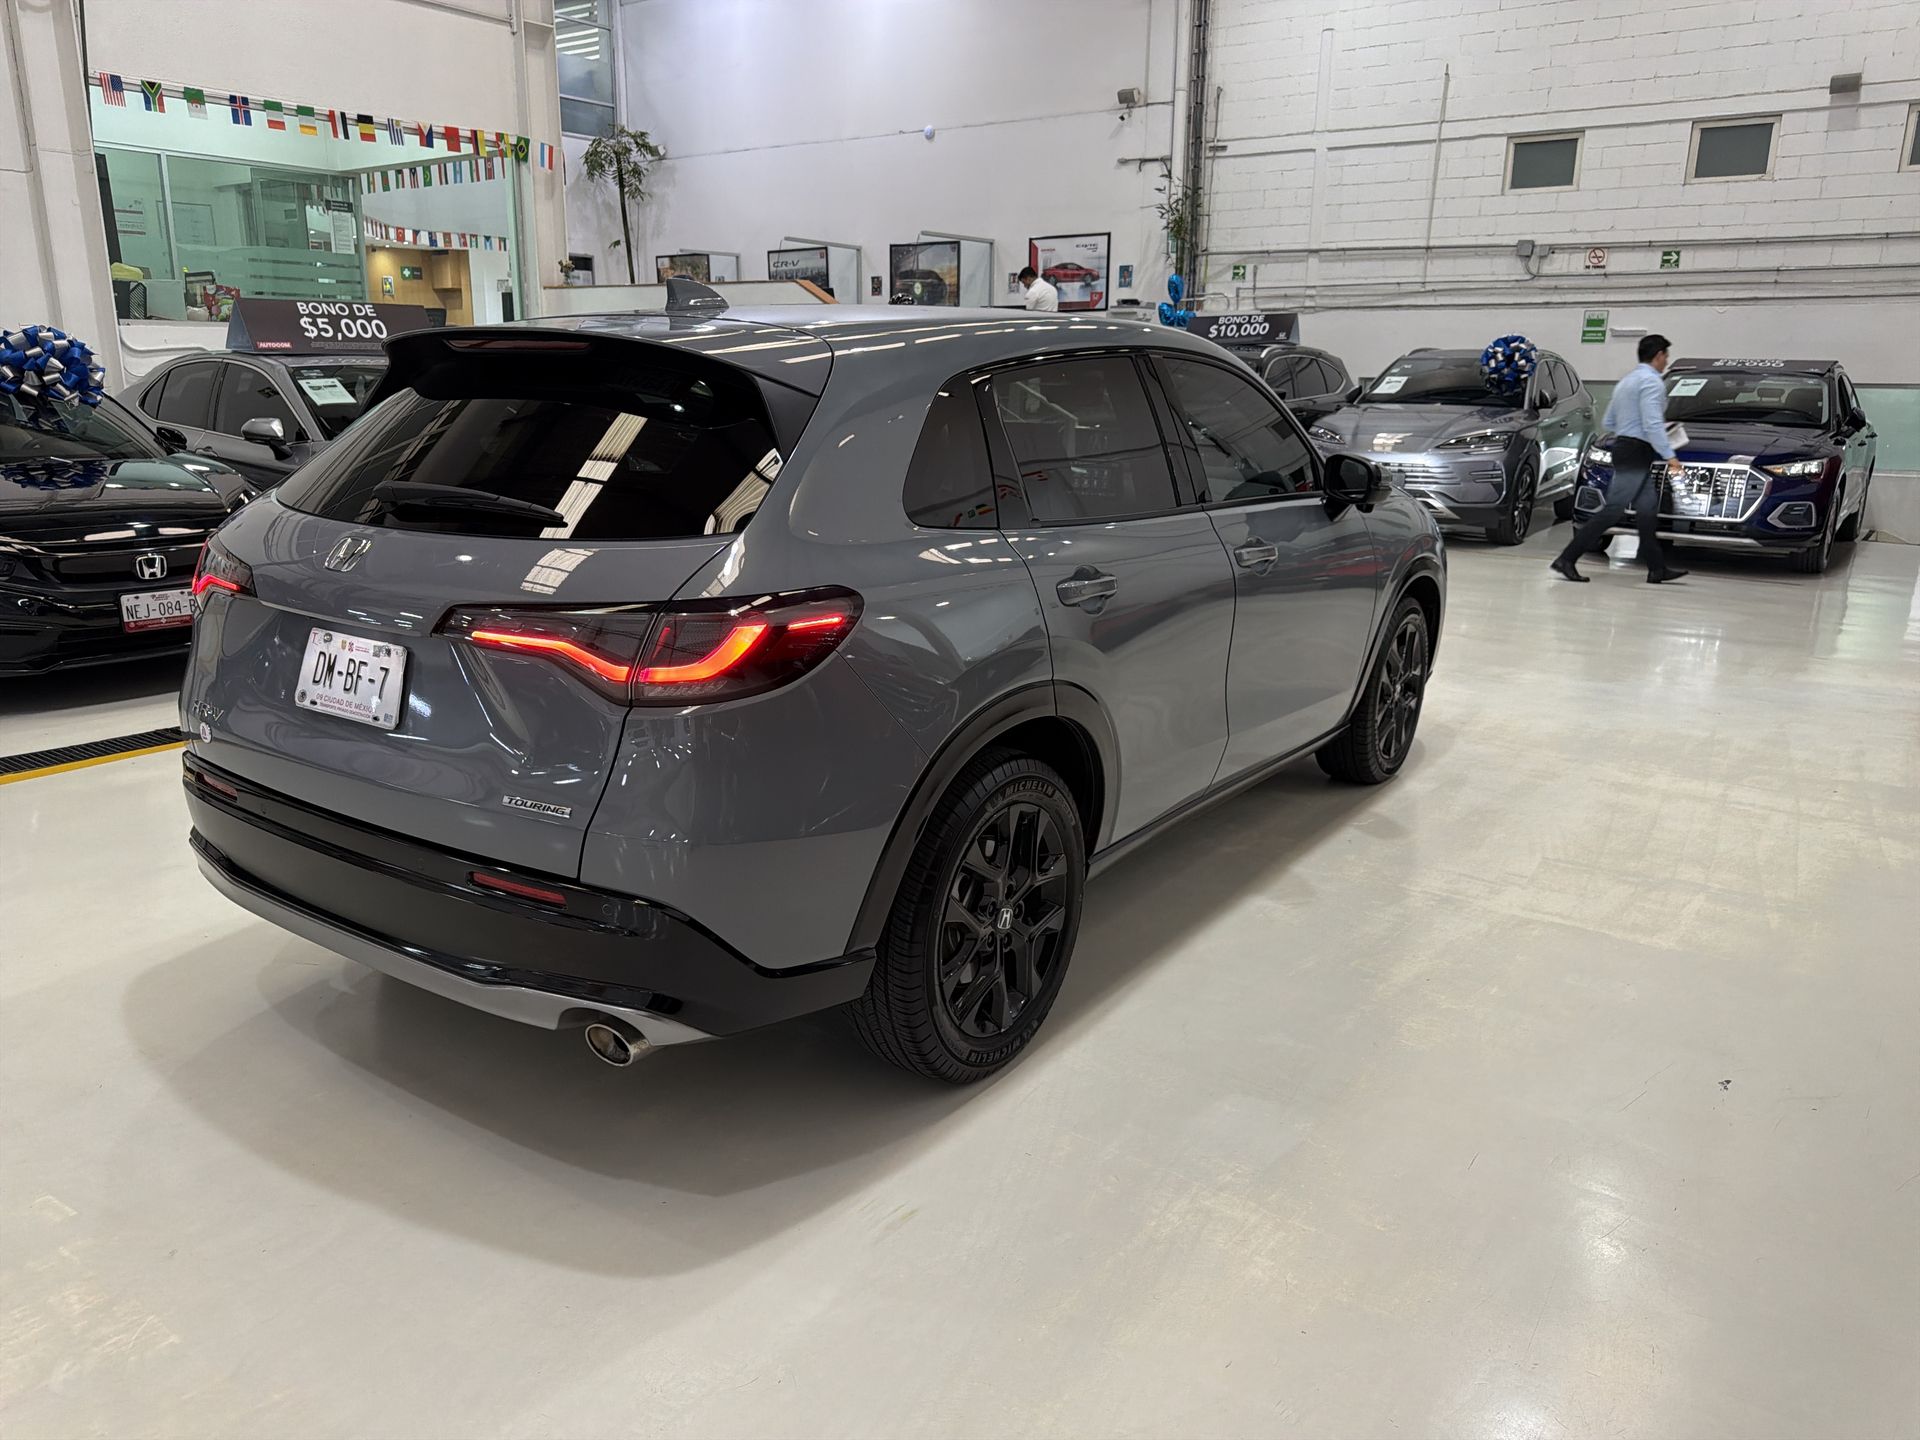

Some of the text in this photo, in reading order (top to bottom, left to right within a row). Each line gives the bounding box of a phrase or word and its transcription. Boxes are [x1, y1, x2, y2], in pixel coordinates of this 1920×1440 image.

[296, 302, 377, 317] BONO DE
[300, 316, 388, 340] $5,000
[1218, 315, 1265, 324] BONO DE
[1208, 322, 1270, 338] $10,000
[312, 651, 390, 700] DM-BF-7
[324, 695, 345, 706] CIUDAD
[345, 700, 354, 709] DE
[1004, 780, 1056, 798] MICHELIN
[507, 797, 567, 815] TOURING
